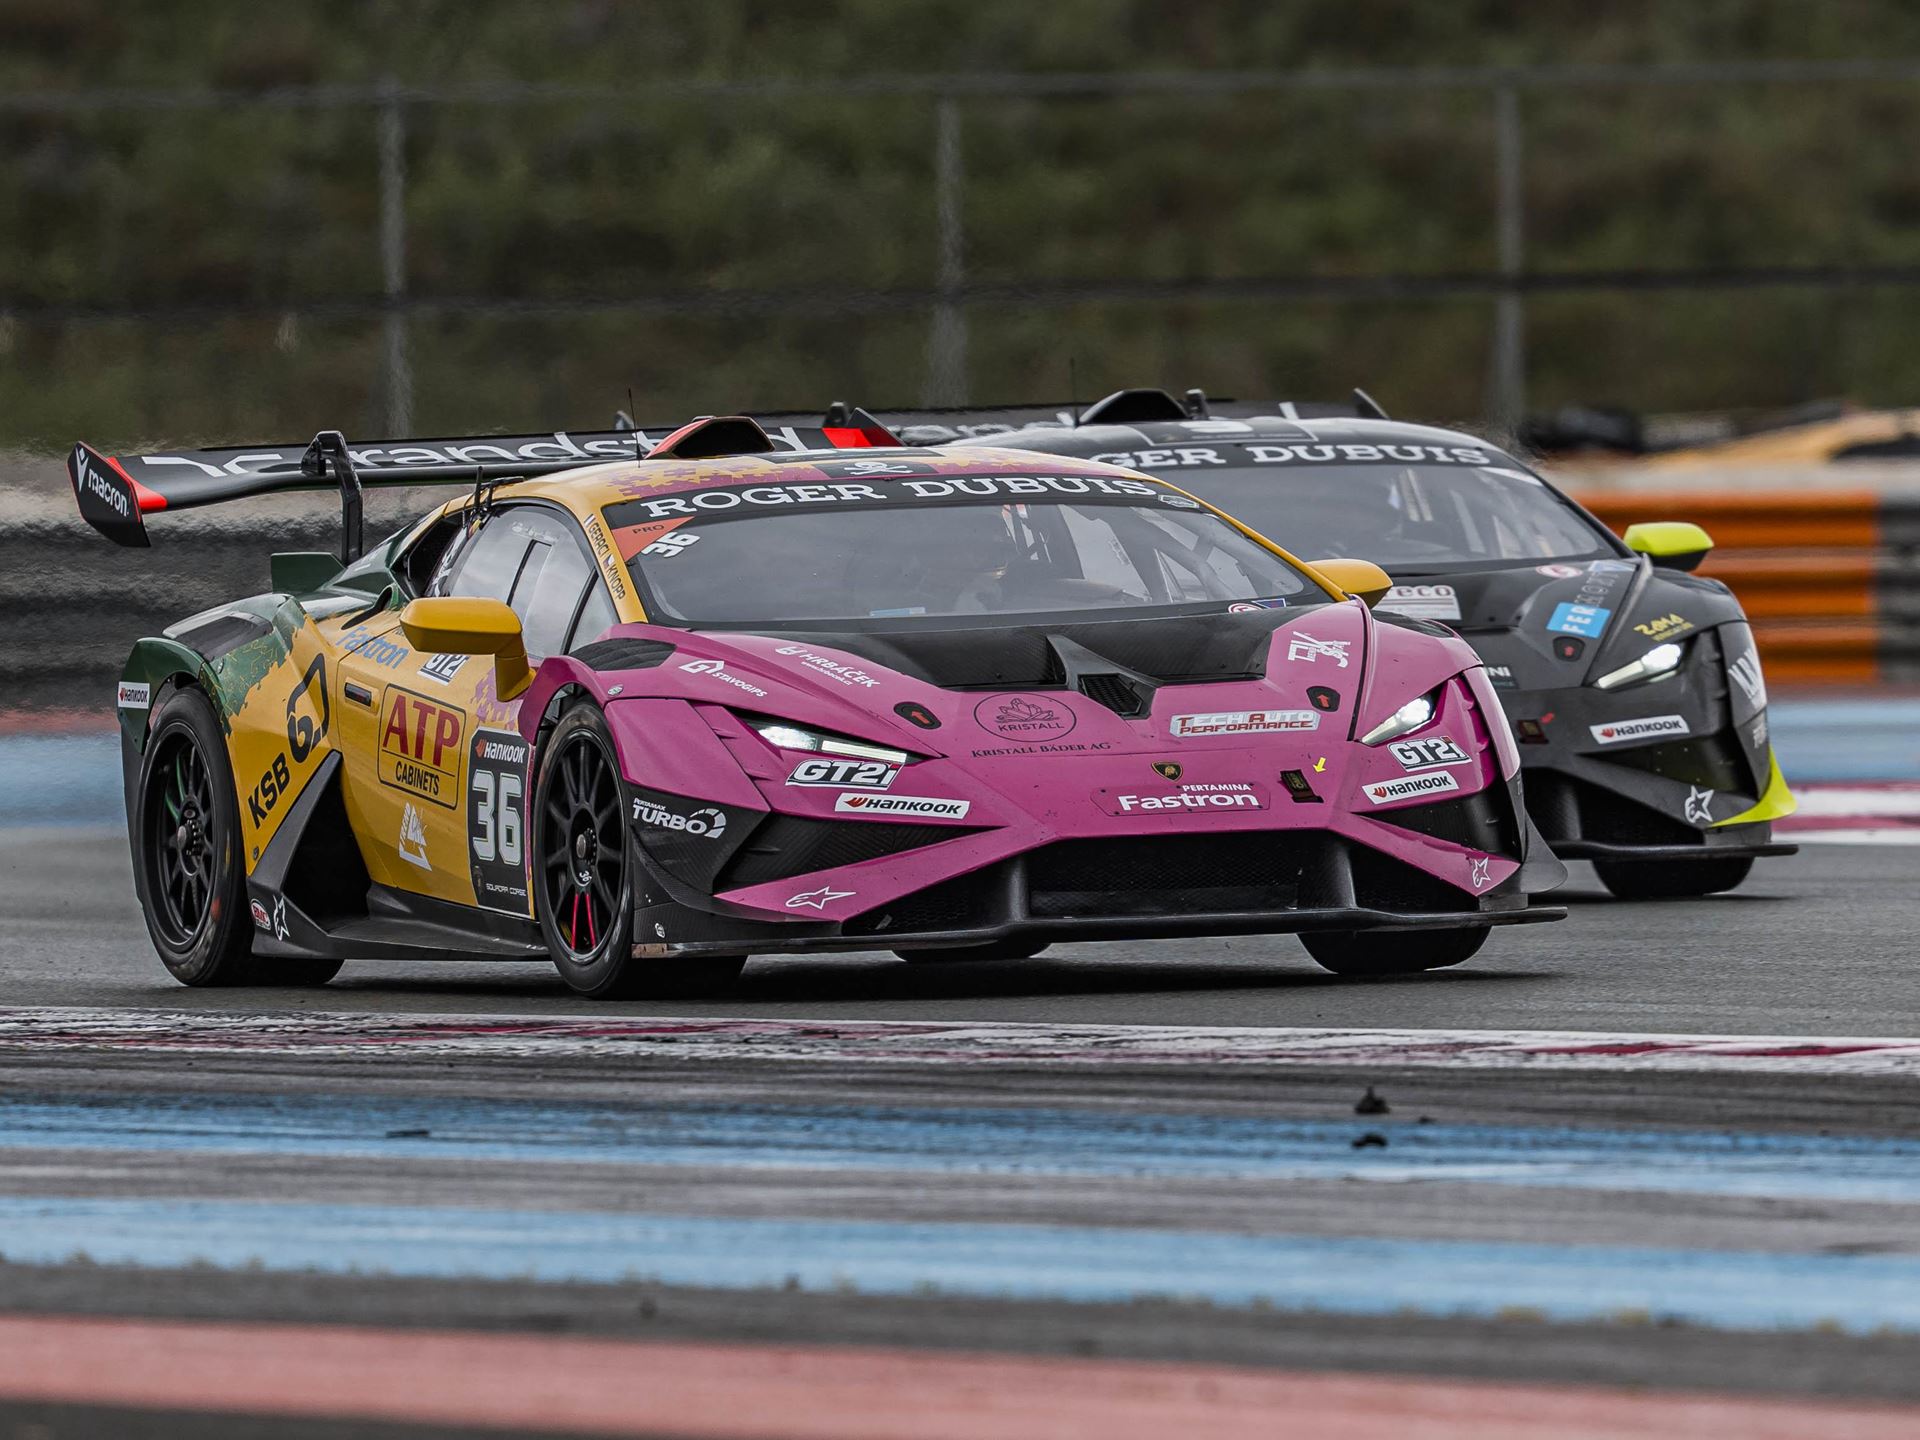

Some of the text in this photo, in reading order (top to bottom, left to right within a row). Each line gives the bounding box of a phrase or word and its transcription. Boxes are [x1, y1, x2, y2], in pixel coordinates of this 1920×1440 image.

[1245, 444, 1490, 464] DUBUIS
[88, 468, 128, 516] macron
[641, 477, 1157, 517] ROGER DUBUIS
[632, 524, 664, 534] PRO
[641, 532, 700, 557] 36
[588, 522, 626, 600] GERACI KNOPP
[336, 626, 409, 669] Fastron
[712, 672, 767, 697] STAVOGIPS
[383, 695, 460, 767] ATP
[998, 723, 1064, 732] KRISTALL
[1180, 721, 1313, 734] PERFORMANCE
[972, 742, 1111, 758] KRISTALL BÄDER AG
[1390, 737, 1466, 765] GT2i
[395, 761, 440, 796] CABINETS
[793, 761, 900, 785] GT2i
[248, 752, 290, 829] KSB
[1183, 784, 1251, 792] PERTAMINA
[633, 797, 666, 811] PERTAMAX
[1118, 793, 1259, 811] Fastron
[472, 769, 522, 866] 36
[632, 804, 708, 834] TURBO
[579, 871, 592, 882] 36
